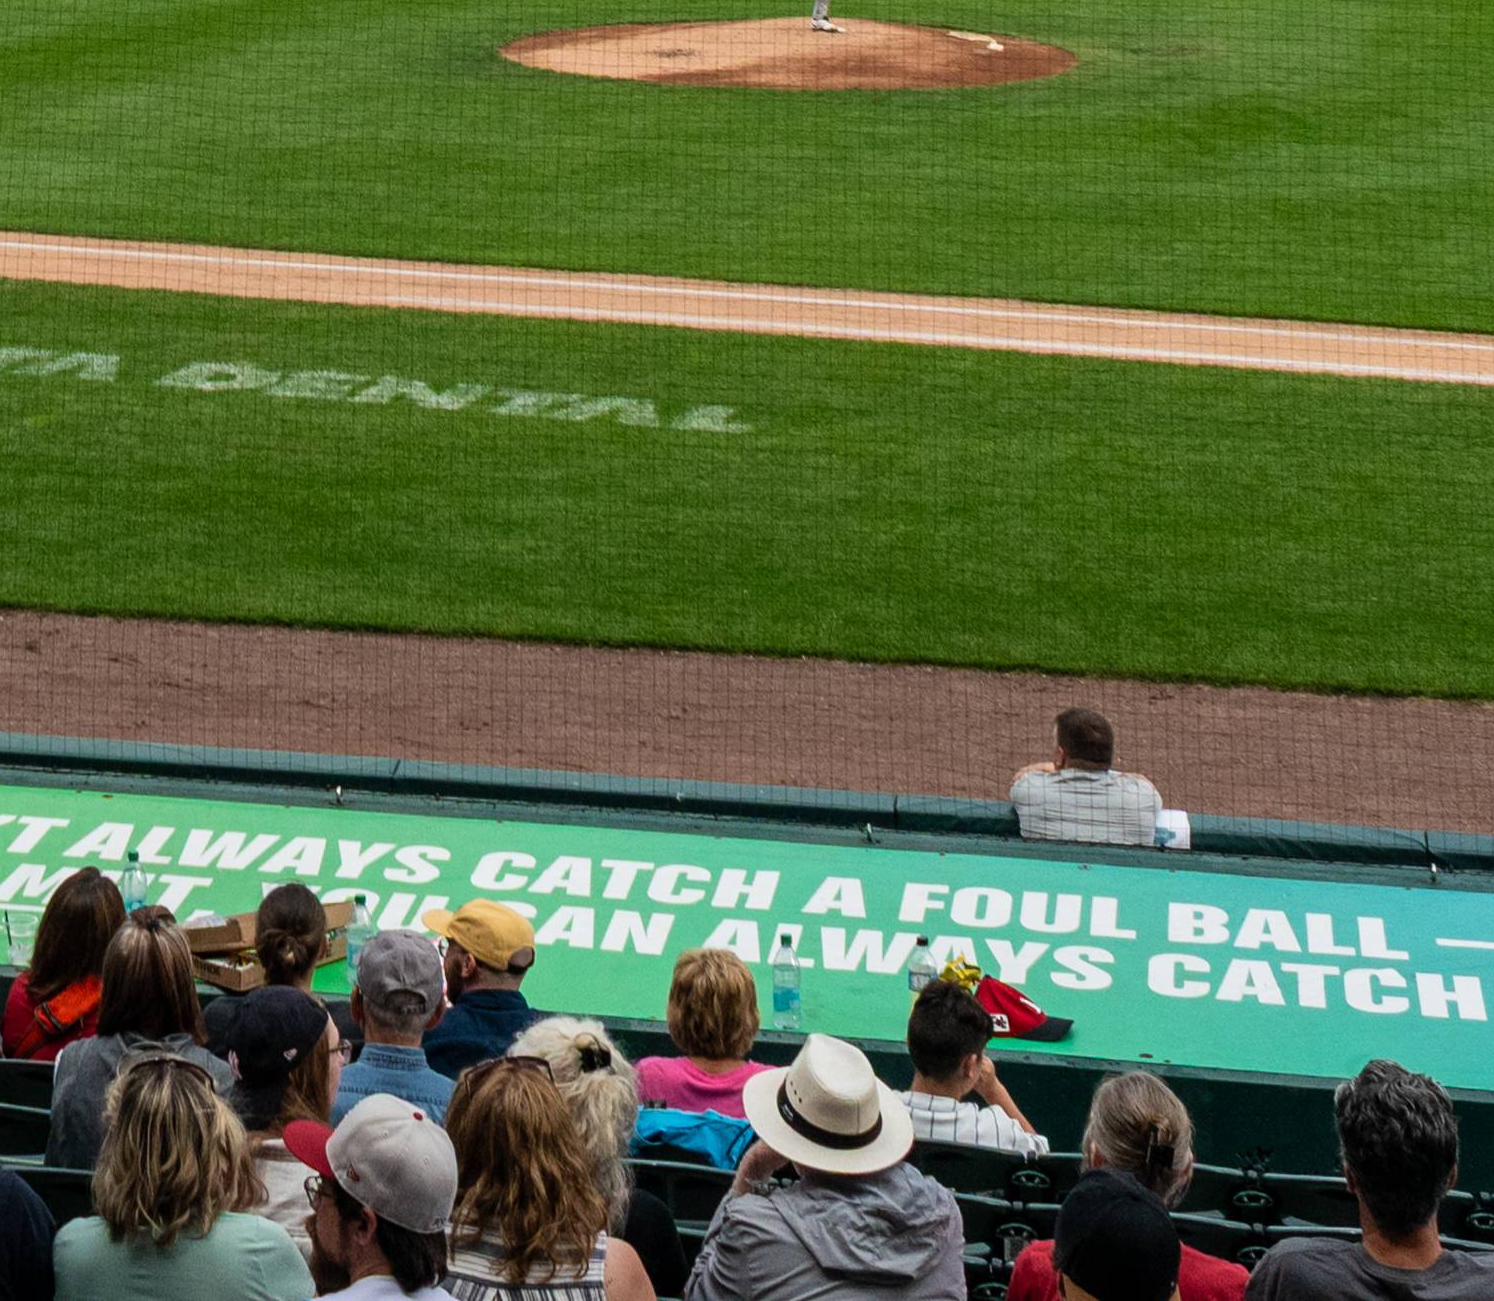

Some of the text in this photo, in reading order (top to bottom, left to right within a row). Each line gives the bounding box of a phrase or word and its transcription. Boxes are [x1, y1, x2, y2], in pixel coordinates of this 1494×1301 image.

[157, 359, 757, 434] DENTAL
[63, 821, 452, 884] ALWAYS
[469, 850, 781, 911] CATCH
[800, 875, 867, 919] A
[898, 882, 1137, 939] FOUL
[1167, 901, 1410, 961] BALL
[510, 898, 676, 956] AN
[702, 917, 1115, 990] ALWAYS
[1146, 952, 1489, 1022] CATCH
